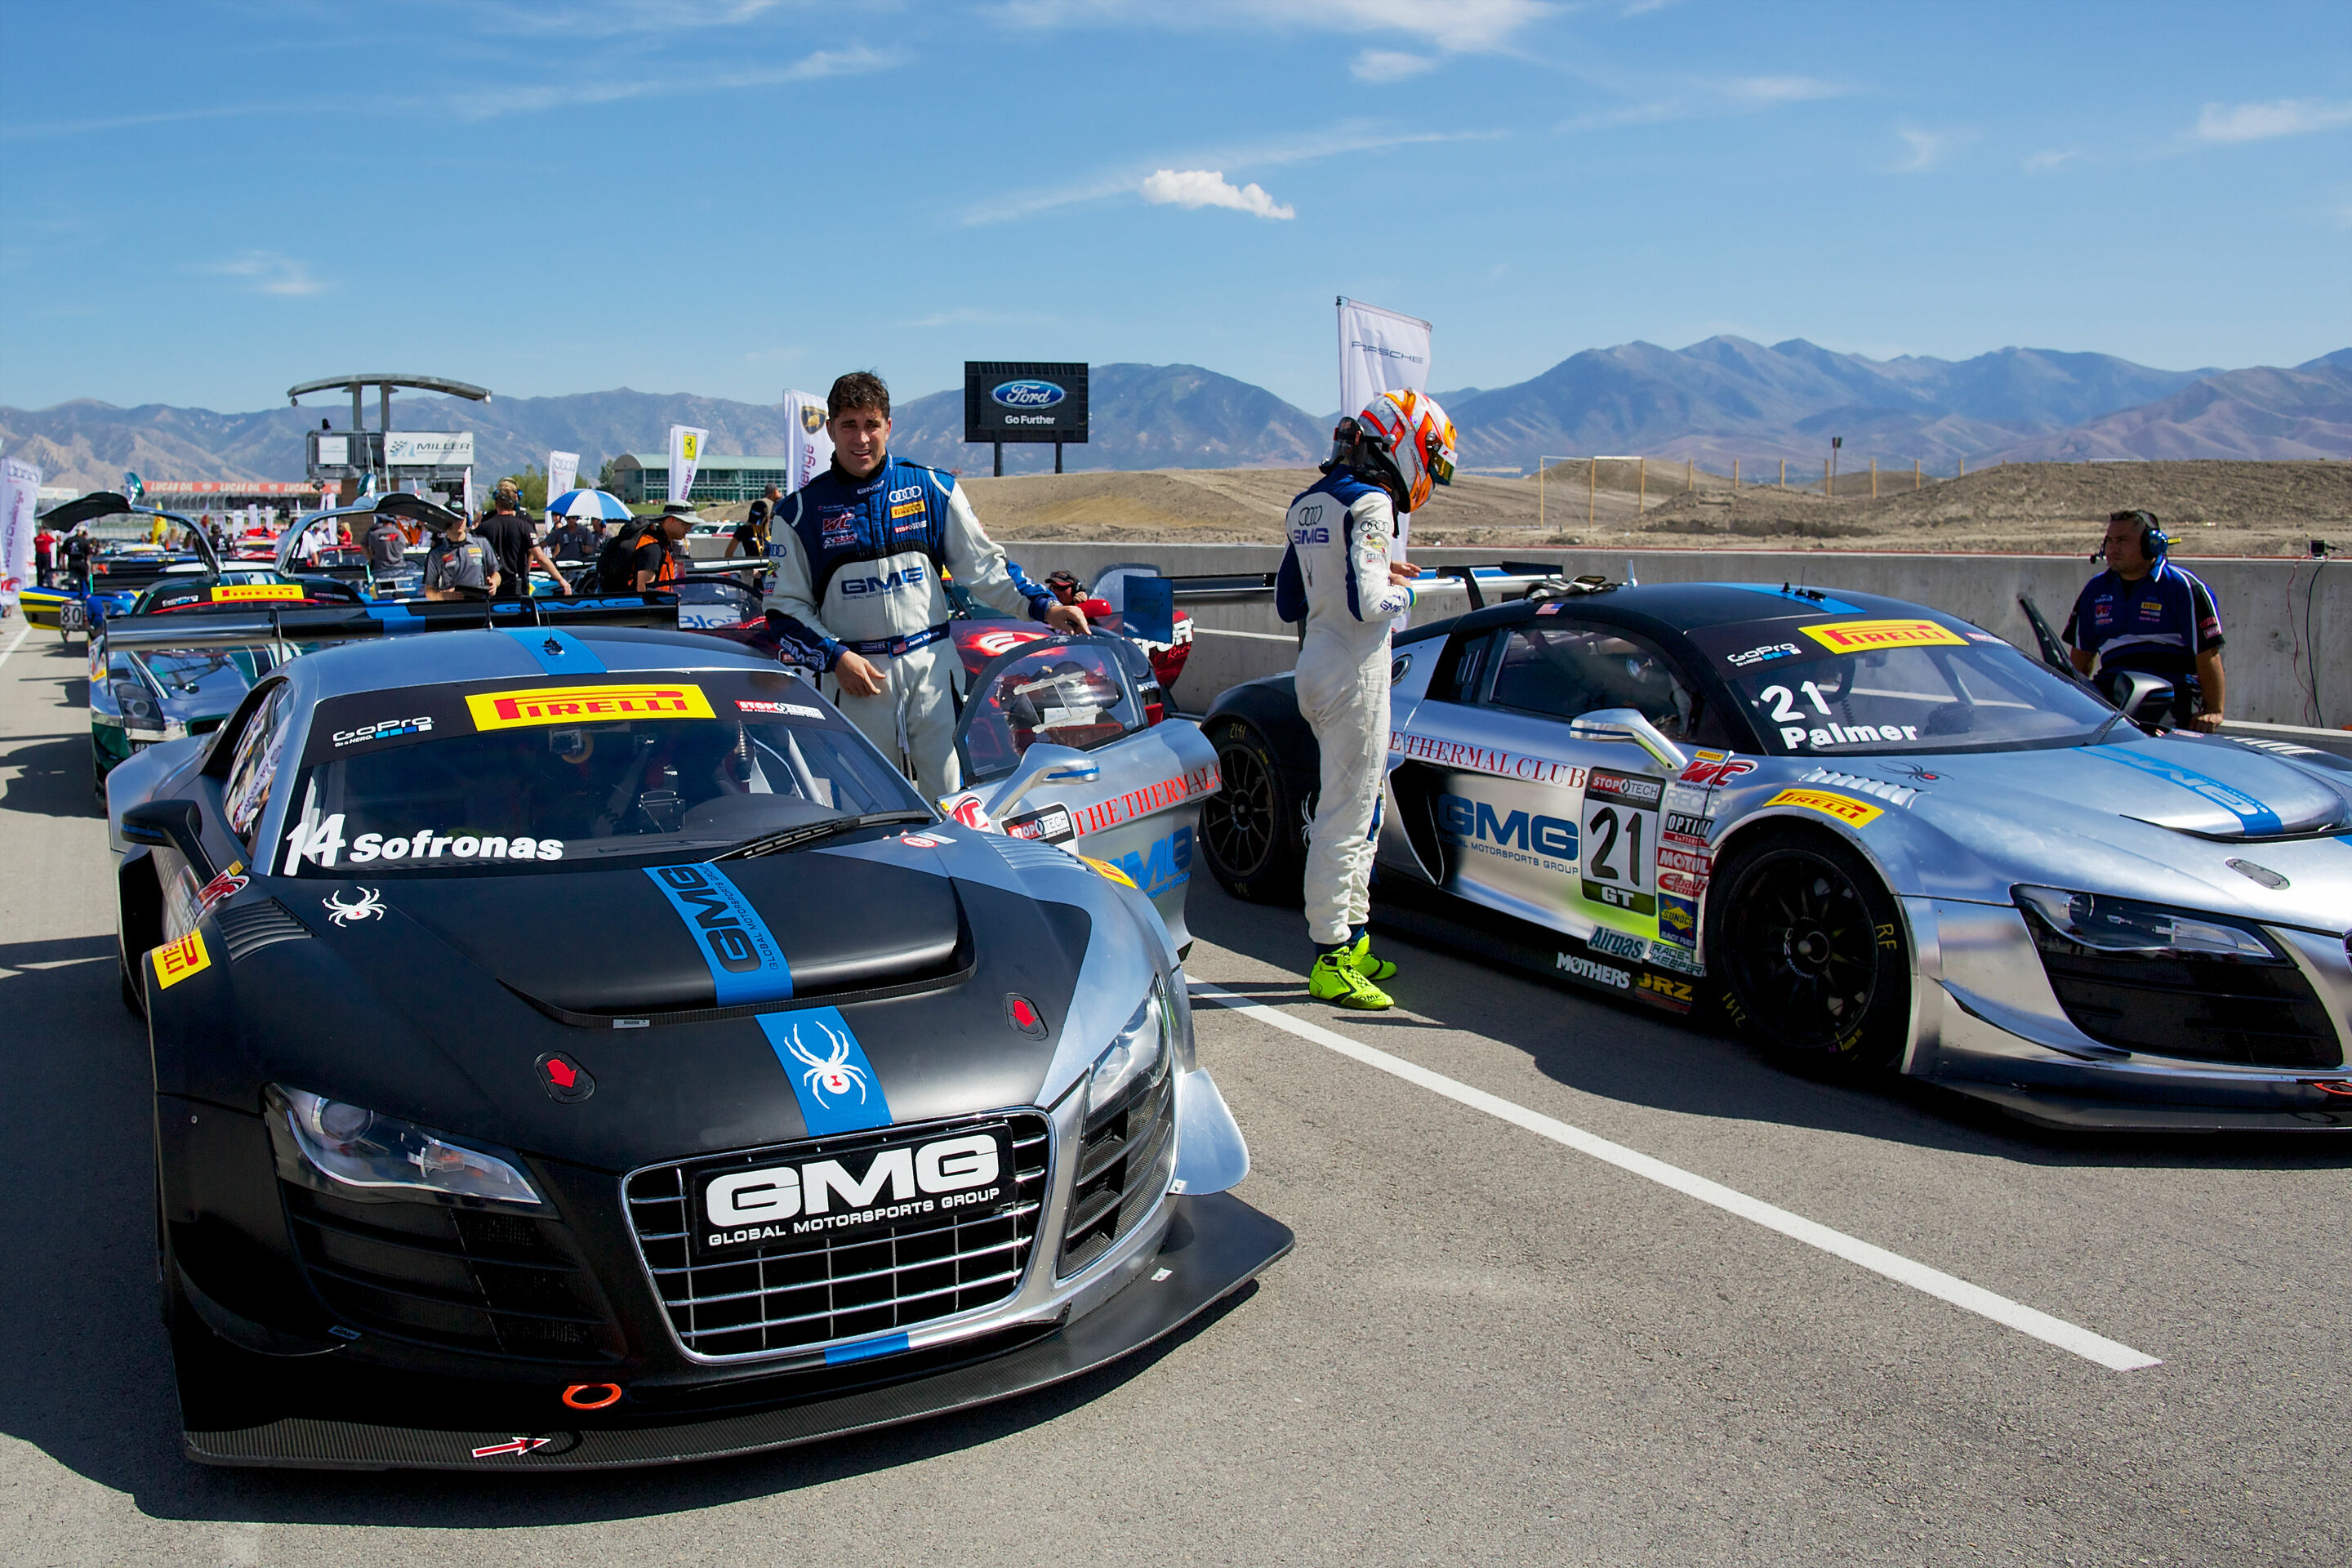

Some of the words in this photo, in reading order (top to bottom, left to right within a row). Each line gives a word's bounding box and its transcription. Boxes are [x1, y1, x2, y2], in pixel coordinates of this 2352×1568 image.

[1005, 383, 1052, 403] Ford
[1004, 415, 1019, 425] Go
[1021, 414, 1056, 425] Further
[416, 443, 470, 451] MILLER
[150, 482, 178, 492] LUCAS
[180, 482, 194, 492] OIL
[220, 483, 245, 492] LUCAS
[246, 483, 261, 492] OIL
[284, 483, 310, 492] LUCAS
[1293, 528, 1330, 545] GMG
[840, 567, 924, 595] GMG
[61, 605, 82, 624] 80
[492, 597, 644, 614] GMG
[1822, 624, 1951, 647] PIRELLI
[1727, 643, 1796, 662] GoPro
[493, 691, 688, 720] PIRELLI
[1759, 680, 1832, 723] 21
[332, 716, 432, 742] GoPro
[1780, 721, 1918, 750] Palmer
[1405, 734, 1511, 774] THERMAL
[1516, 756, 1587, 790] CLUB
[1679, 760, 1756, 787] WC
[1593, 776, 1659, 798] STOPTECH
[1071, 798, 1123, 837] THE
[1121, 767, 1215, 819] THERMAL
[1774, 791, 1868, 820] PIRELLI
[1437, 792, 1579, 862] GMG
[1667, 814, 1712, 836] OPTIM
[283, 813, 346, 876] 14
[350, 830, 564, 862] Sofronas
[1589, 806, 1642, 887] 21
[1471, 842, 1539, 866] MOTORSPORTS
[1544, 860, 1579, 875] GROUP
[1659, 849, 1710, 874] MOTUL
[715, 881, 757, 931] MOTORSPORTS
[1601, 885, 1634, 907] GT
[657, 866, 762, 973] GMG
[1663, 910, 1694, 925] SUNOCO
[1588, 926, 1645, 959] Airgas
[1875, 923, 1898, 950] RF
[753, 932, 779, 970] GLOBAL
[1650, 952, 1704, 976] KEEPER
[1556, 951, 1631, 990] MOTHERS
[706, 1134, 1000, 1227] GMG
[708, 1224, 787, 1247] GLOBAL
[794, 1199, 935, 1235] MOTORSPORTS
[941, 1187, 1000, 1209] GROUP
